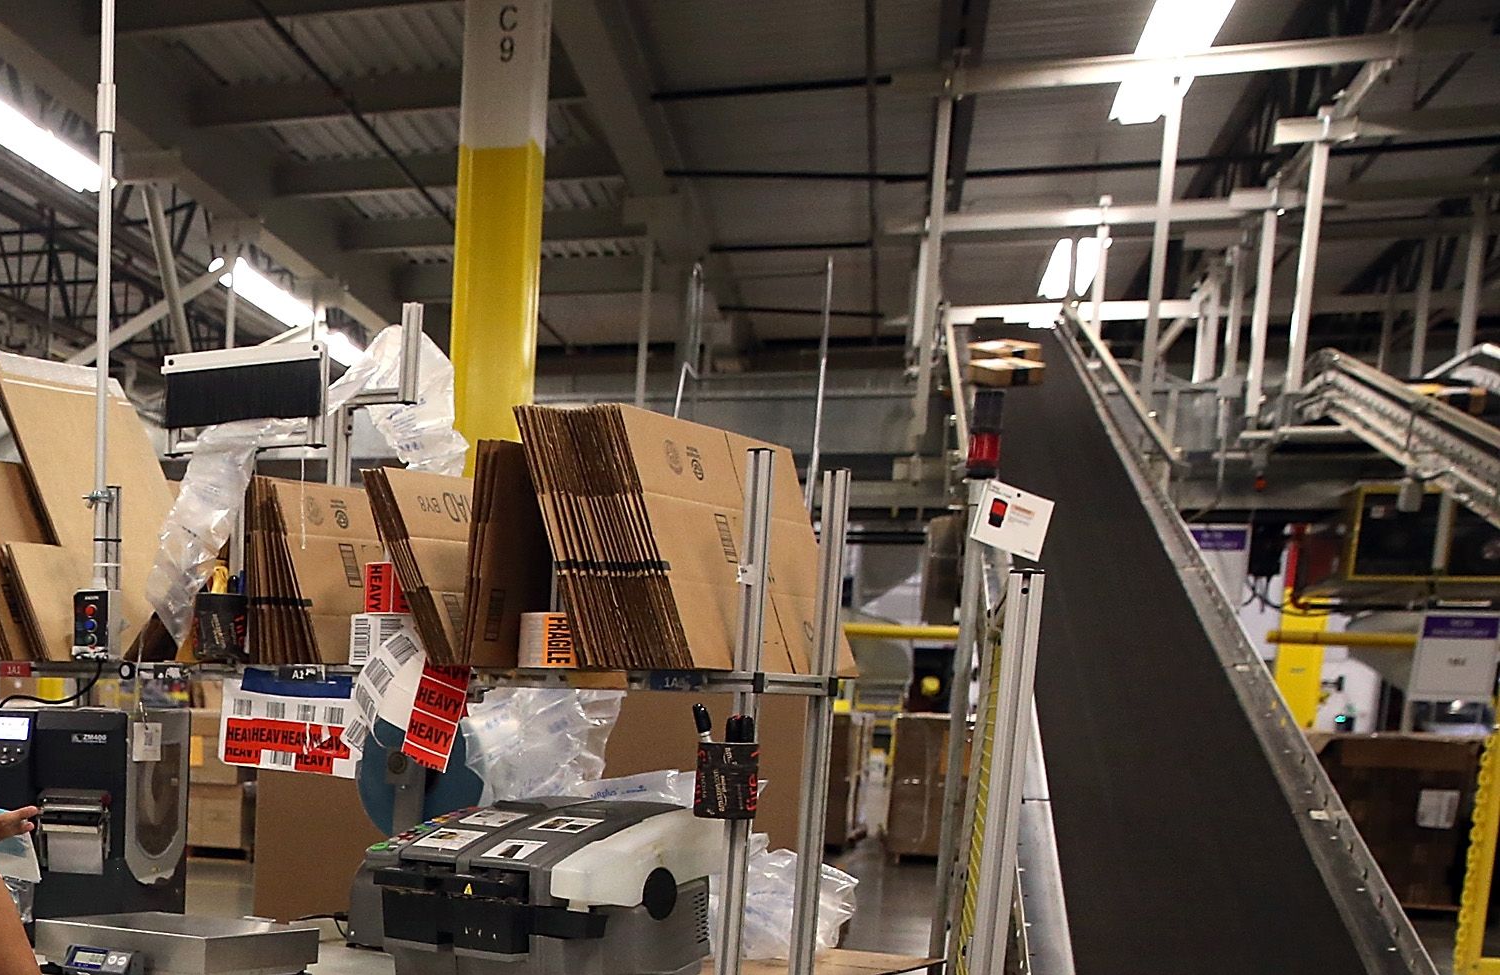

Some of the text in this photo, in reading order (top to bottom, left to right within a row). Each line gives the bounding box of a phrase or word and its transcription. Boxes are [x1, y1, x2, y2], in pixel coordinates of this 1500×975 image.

[499, 5, 518, 31] C
[499, 36, 514, 63] 9
[368, 565, 383, 611] HEAVY
[547, 616, 574, 664] FRAGILE
[417, 686, 462, 714] HEAVY
[251, 727, 281, 743] HEAV
[408, 718, 453, 748] HEAVY
